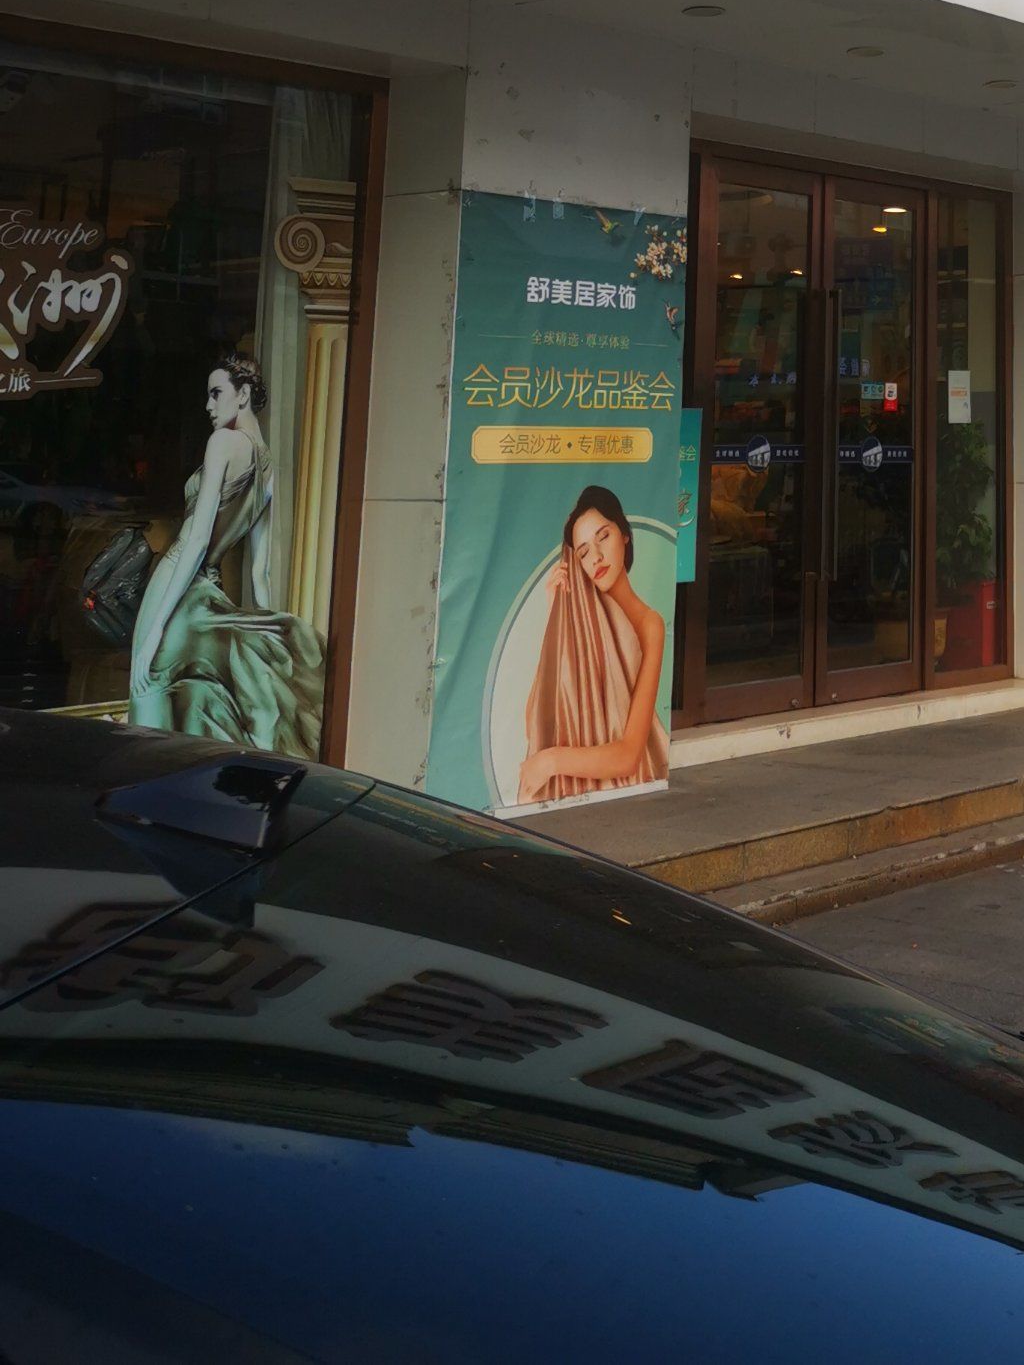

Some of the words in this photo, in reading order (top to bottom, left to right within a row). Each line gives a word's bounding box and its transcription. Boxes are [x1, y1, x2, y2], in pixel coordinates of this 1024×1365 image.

[527, 276, 637, 311] 舒美居家饰
[463, 363, 676, 411] 会员沙龙品鉴会
